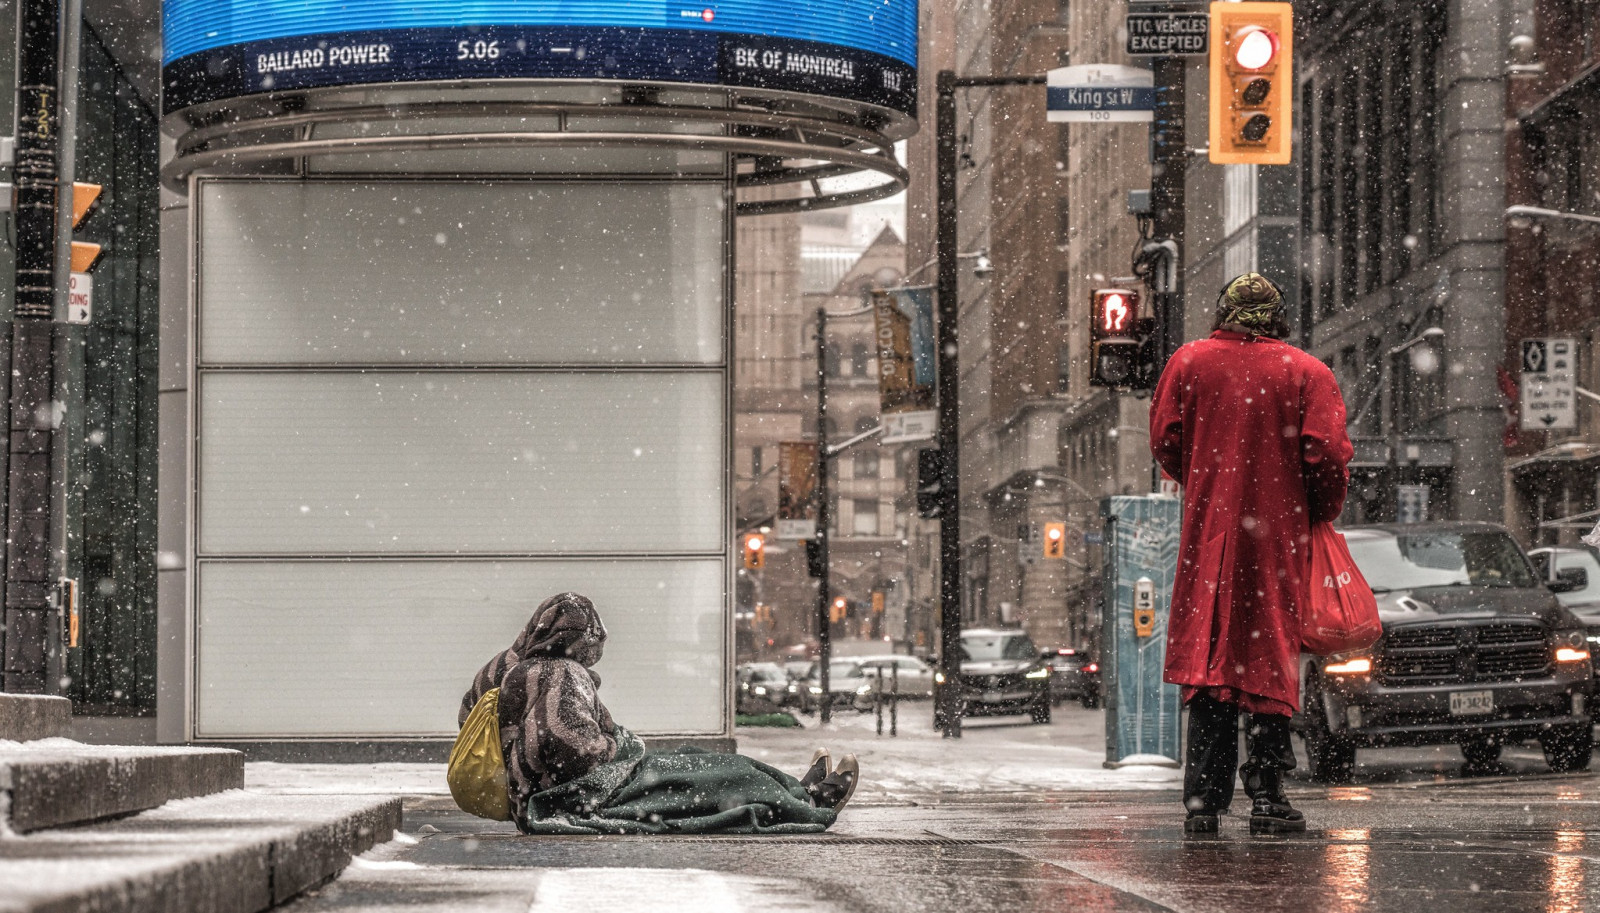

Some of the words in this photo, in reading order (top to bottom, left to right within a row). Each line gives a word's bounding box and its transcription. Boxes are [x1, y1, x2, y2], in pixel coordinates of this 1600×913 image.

[1129, 20, 1152, 32] TTC
[1155, 20, 1207, 32] VEHICLES
[1131, 36, 1204, 49] EXCEPTED
[258, 48, 324, 73] BALLARD
[329, 44, 390, 66] POWER
[457, 40, 500, 59] 5.06
[735, 48, 759, 68] BK
[762, 51, 783, 70] OF
[786, 52, 855, 80] MONTREAL
[1068, 88, 1102, 108] King
[1120, 88, 1134, 105] W
[1089, 111, 1111, 120] 100
[875, 297, 896, 376] DISCOVER
